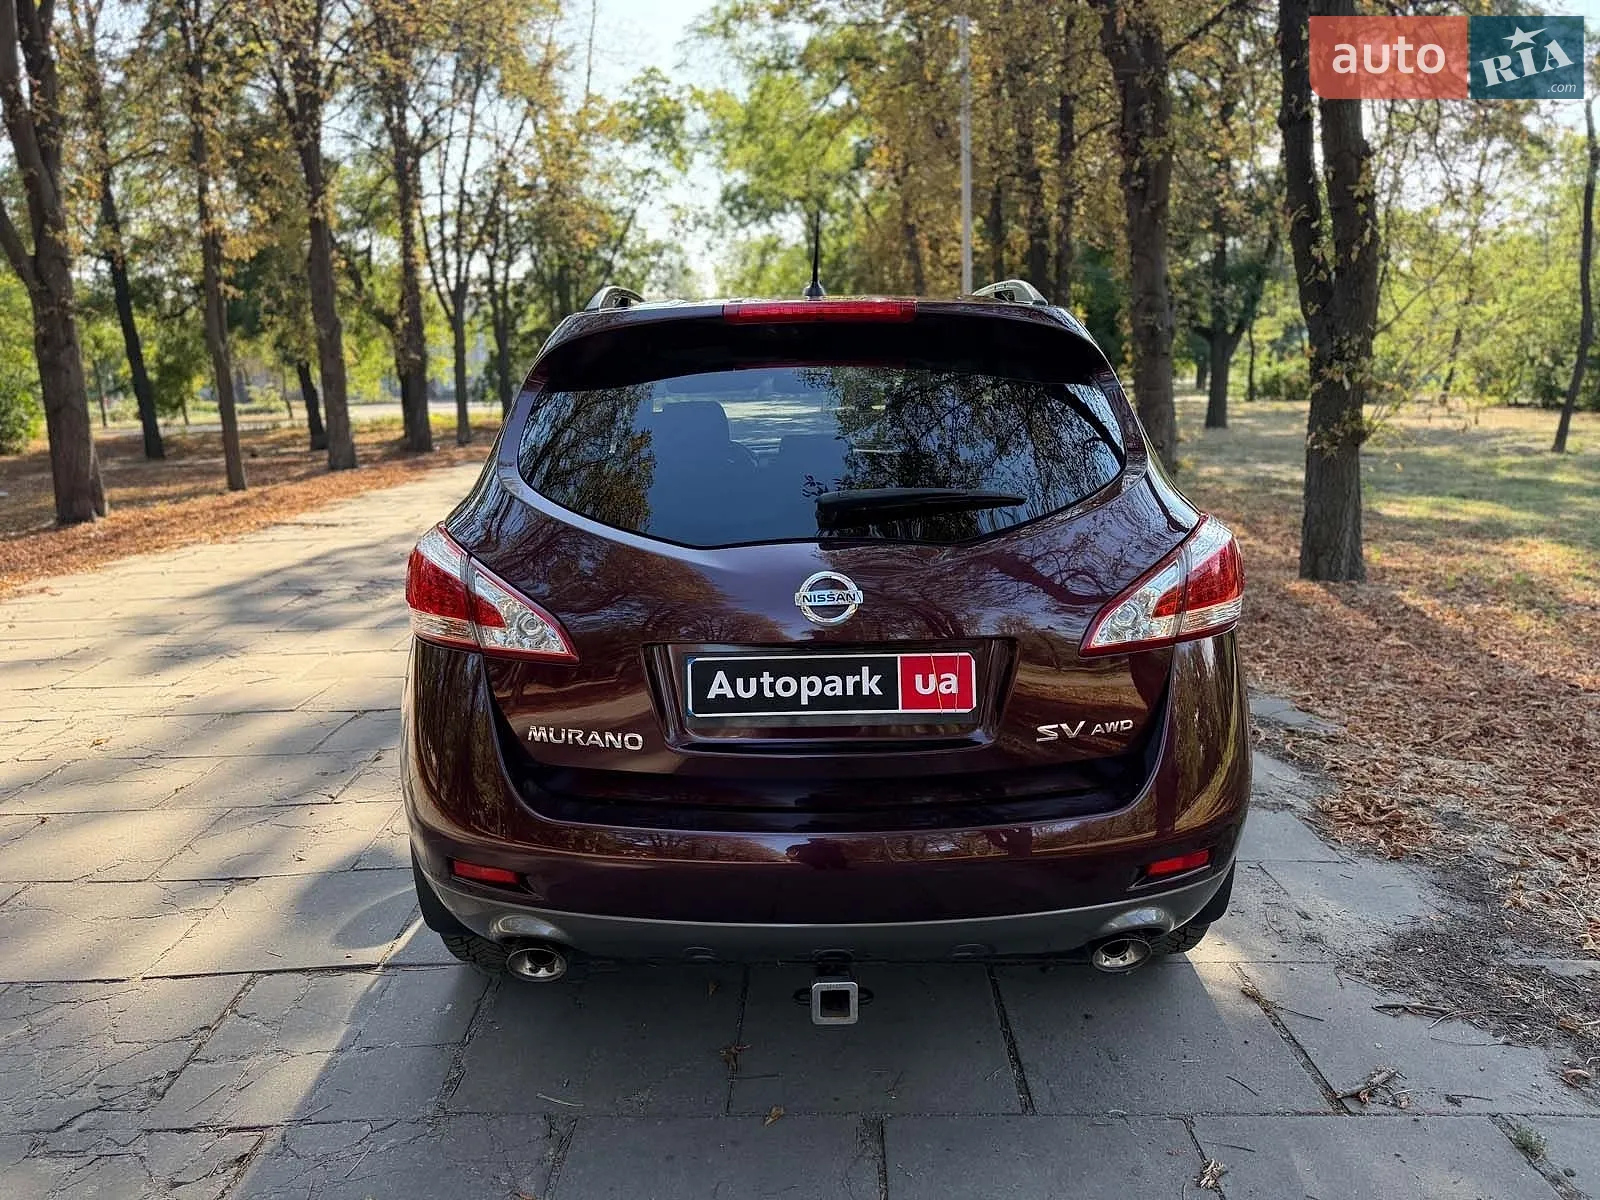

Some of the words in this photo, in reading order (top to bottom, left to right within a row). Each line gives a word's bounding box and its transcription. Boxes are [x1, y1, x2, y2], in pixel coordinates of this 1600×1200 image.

[801, 591, 857, 604] NISSAN
[707, 666, 883, 705] Autopark
[914, 672, 959, 696] ua
[527, 725, 644, 751] MURANO
[1036, 720, 1086, 742] SV
[1090, 719, 1134, 736] AWD
